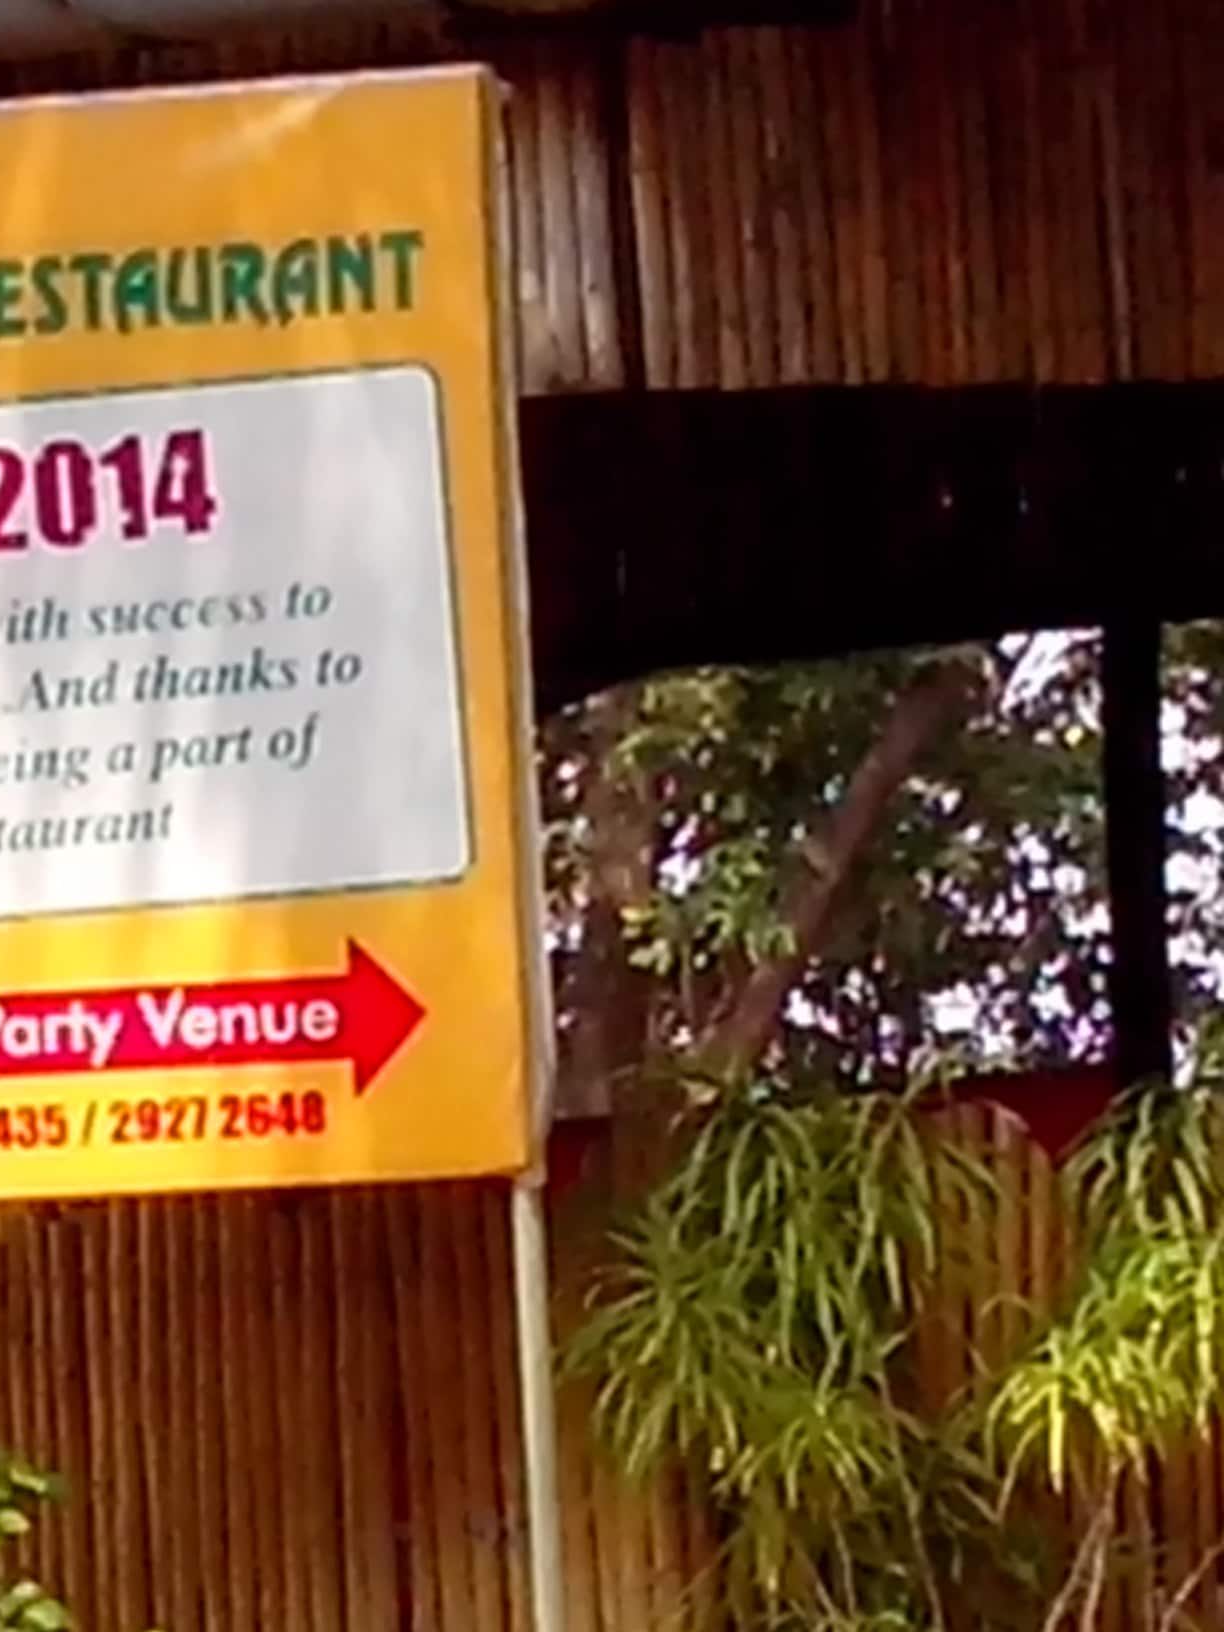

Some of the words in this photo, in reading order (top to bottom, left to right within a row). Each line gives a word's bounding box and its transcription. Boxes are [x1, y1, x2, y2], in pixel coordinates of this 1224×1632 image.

[89, 589, 268, 636] success
[285, 582, 332, 619] to
[133, 648, 298, 703] thanks
[316, 649, 362, 685] to
[107, 741, 134, 774] a
[149, 726, 253, 783] part
[267, 711, 319, 770] of
[136, 986, 339, 1049] Venue
[111, 1097, 207, 1144] 2927
[221, 1090, 326, 1138] 2648
